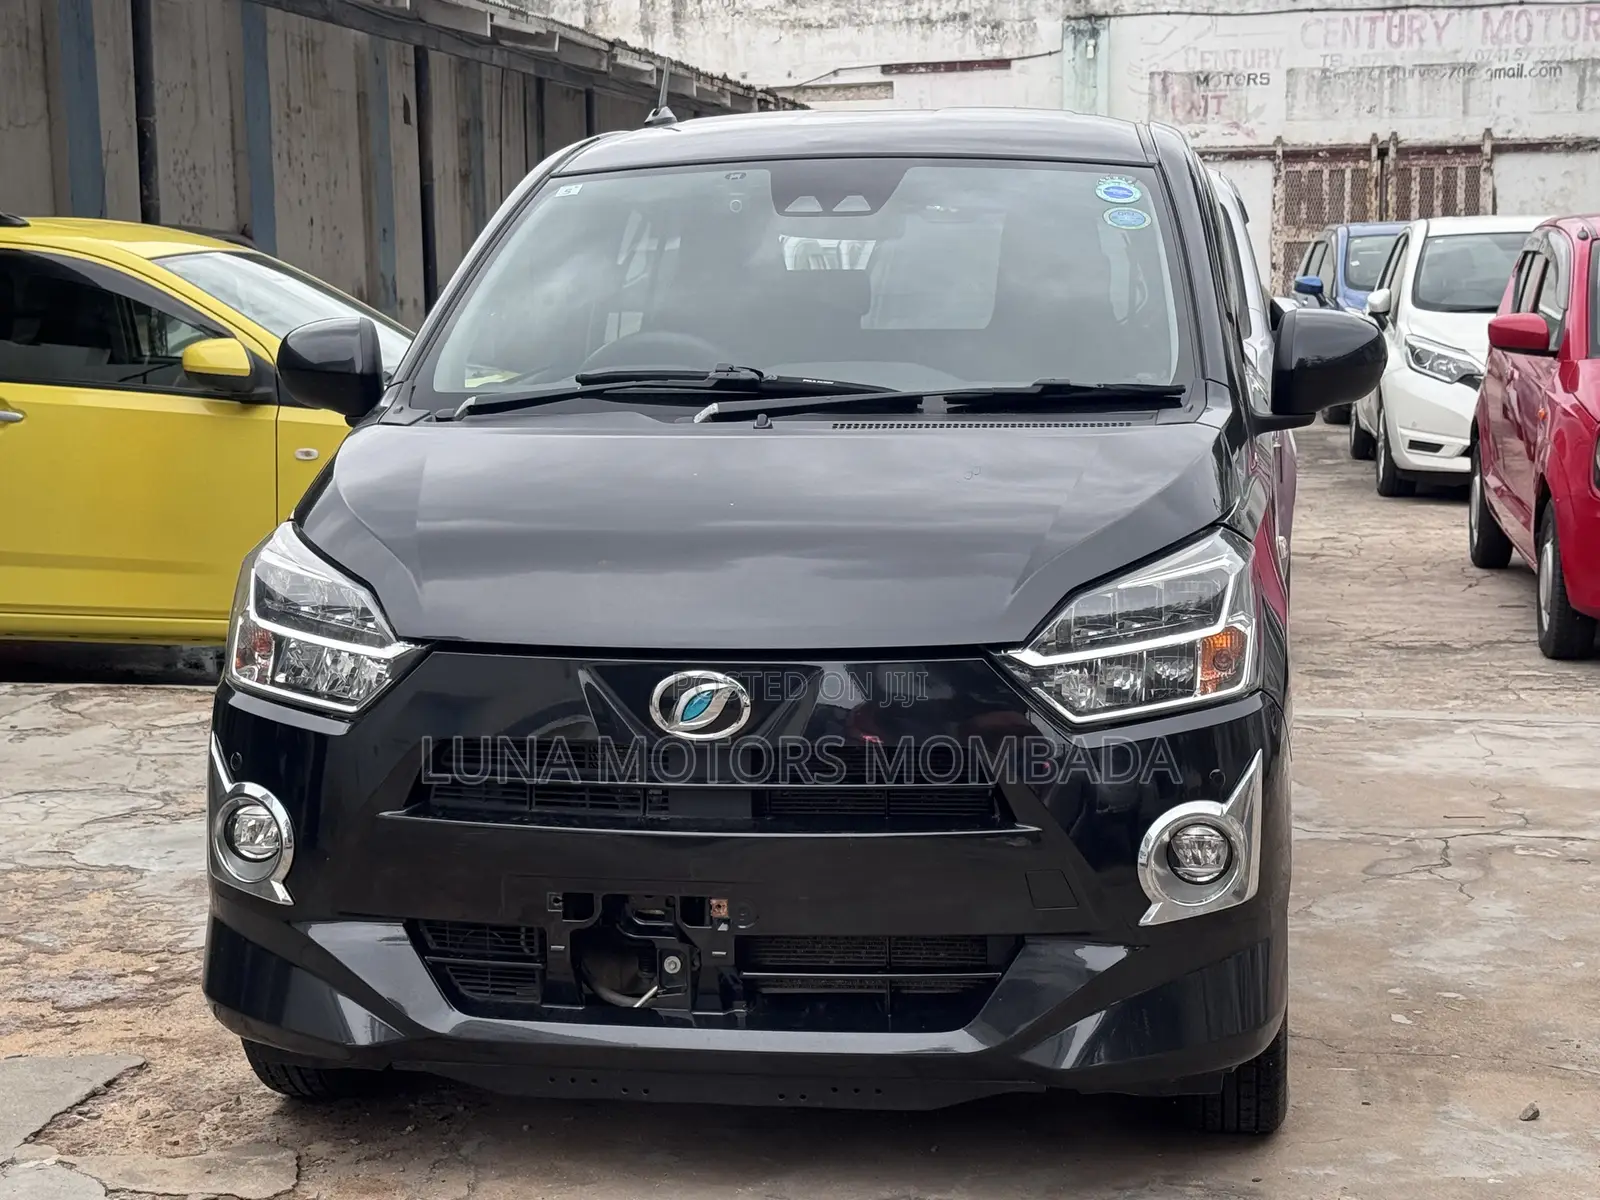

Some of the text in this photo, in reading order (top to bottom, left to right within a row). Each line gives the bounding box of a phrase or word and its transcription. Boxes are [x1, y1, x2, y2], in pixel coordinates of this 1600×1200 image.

[1300, 9, 1455, 49] CENTURY
[1184, 46, 1284, 70] CENTURY
[1195, 72, 1271, 88] MOTORS
